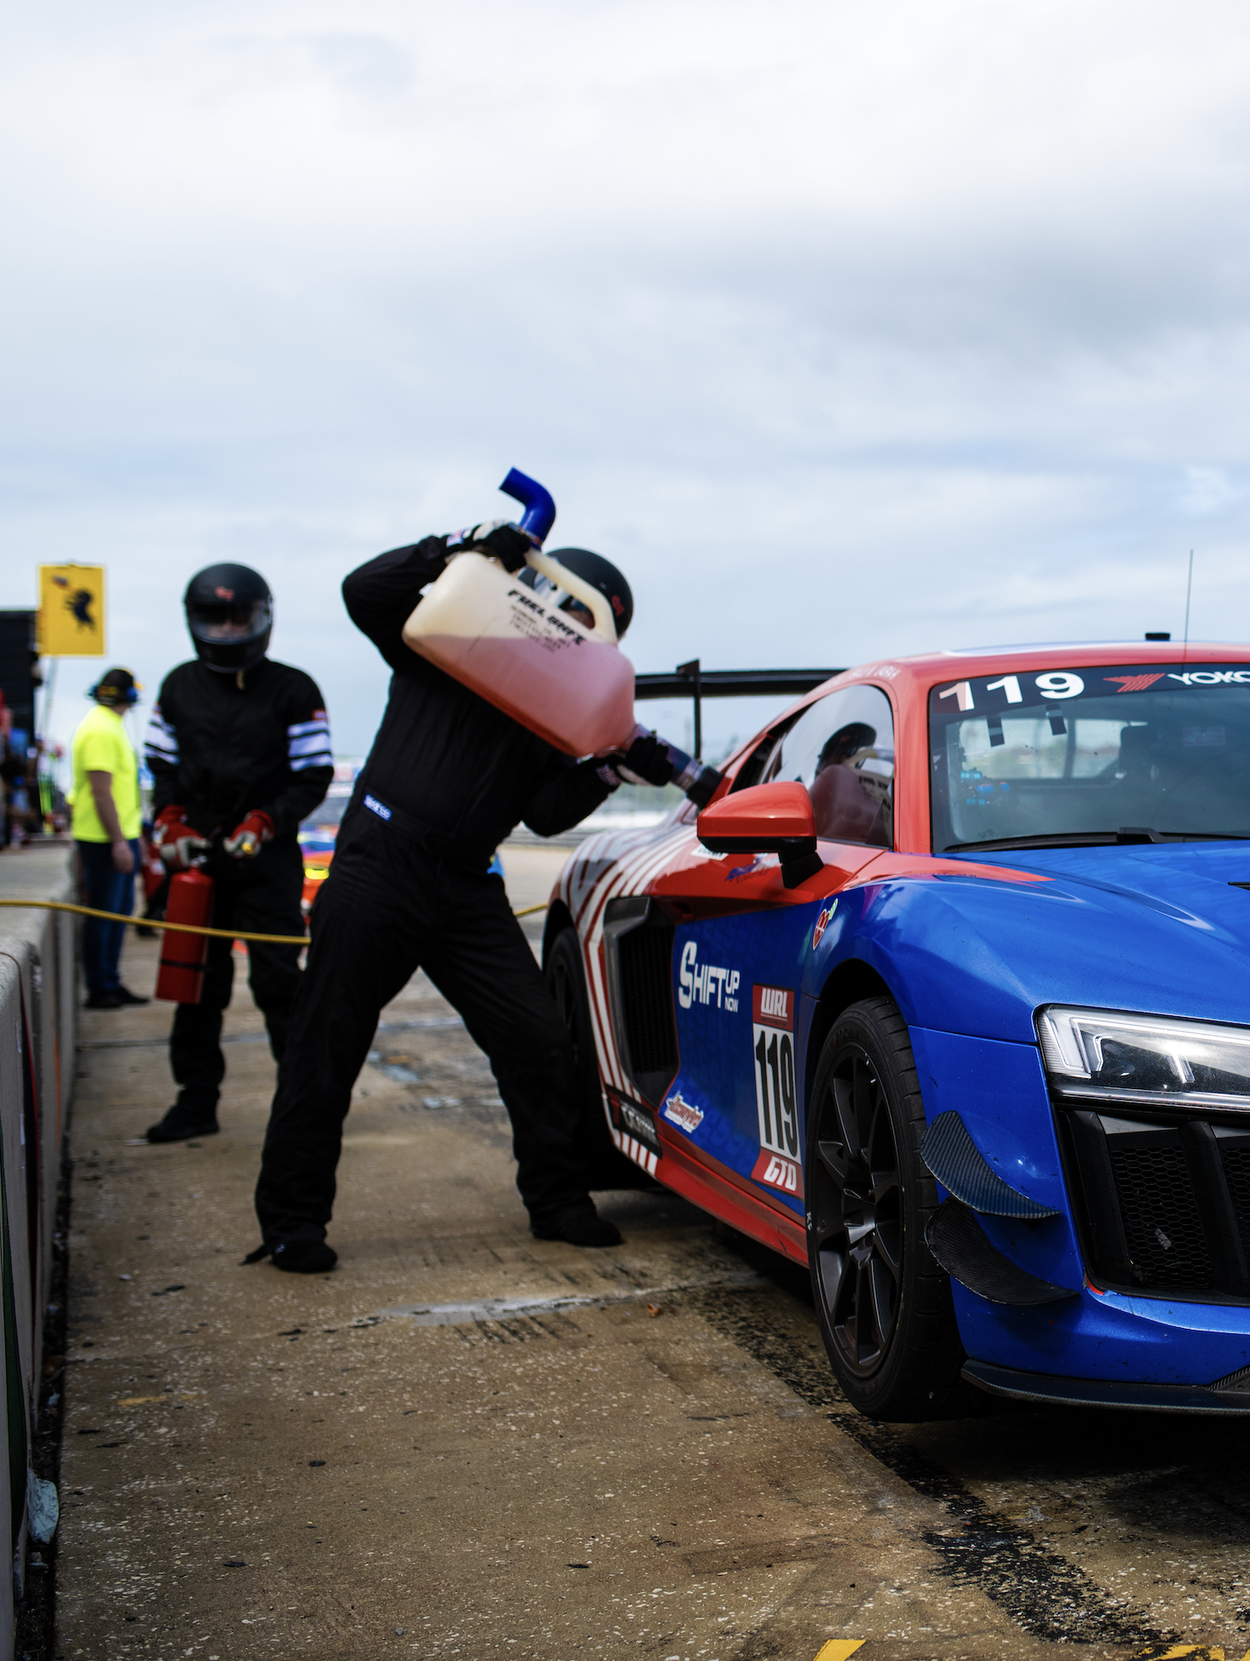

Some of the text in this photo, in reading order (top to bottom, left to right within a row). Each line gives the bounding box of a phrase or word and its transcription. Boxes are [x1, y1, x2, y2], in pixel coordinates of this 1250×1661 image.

[938, 671, 1086, 712] 119
[678, 941, 740, 1009] SHIFT UP
[724, 996, 739, 1013] NOW
[760, 987, 788, 1018] WRL
[755, 1029, 799, 1158] 119
